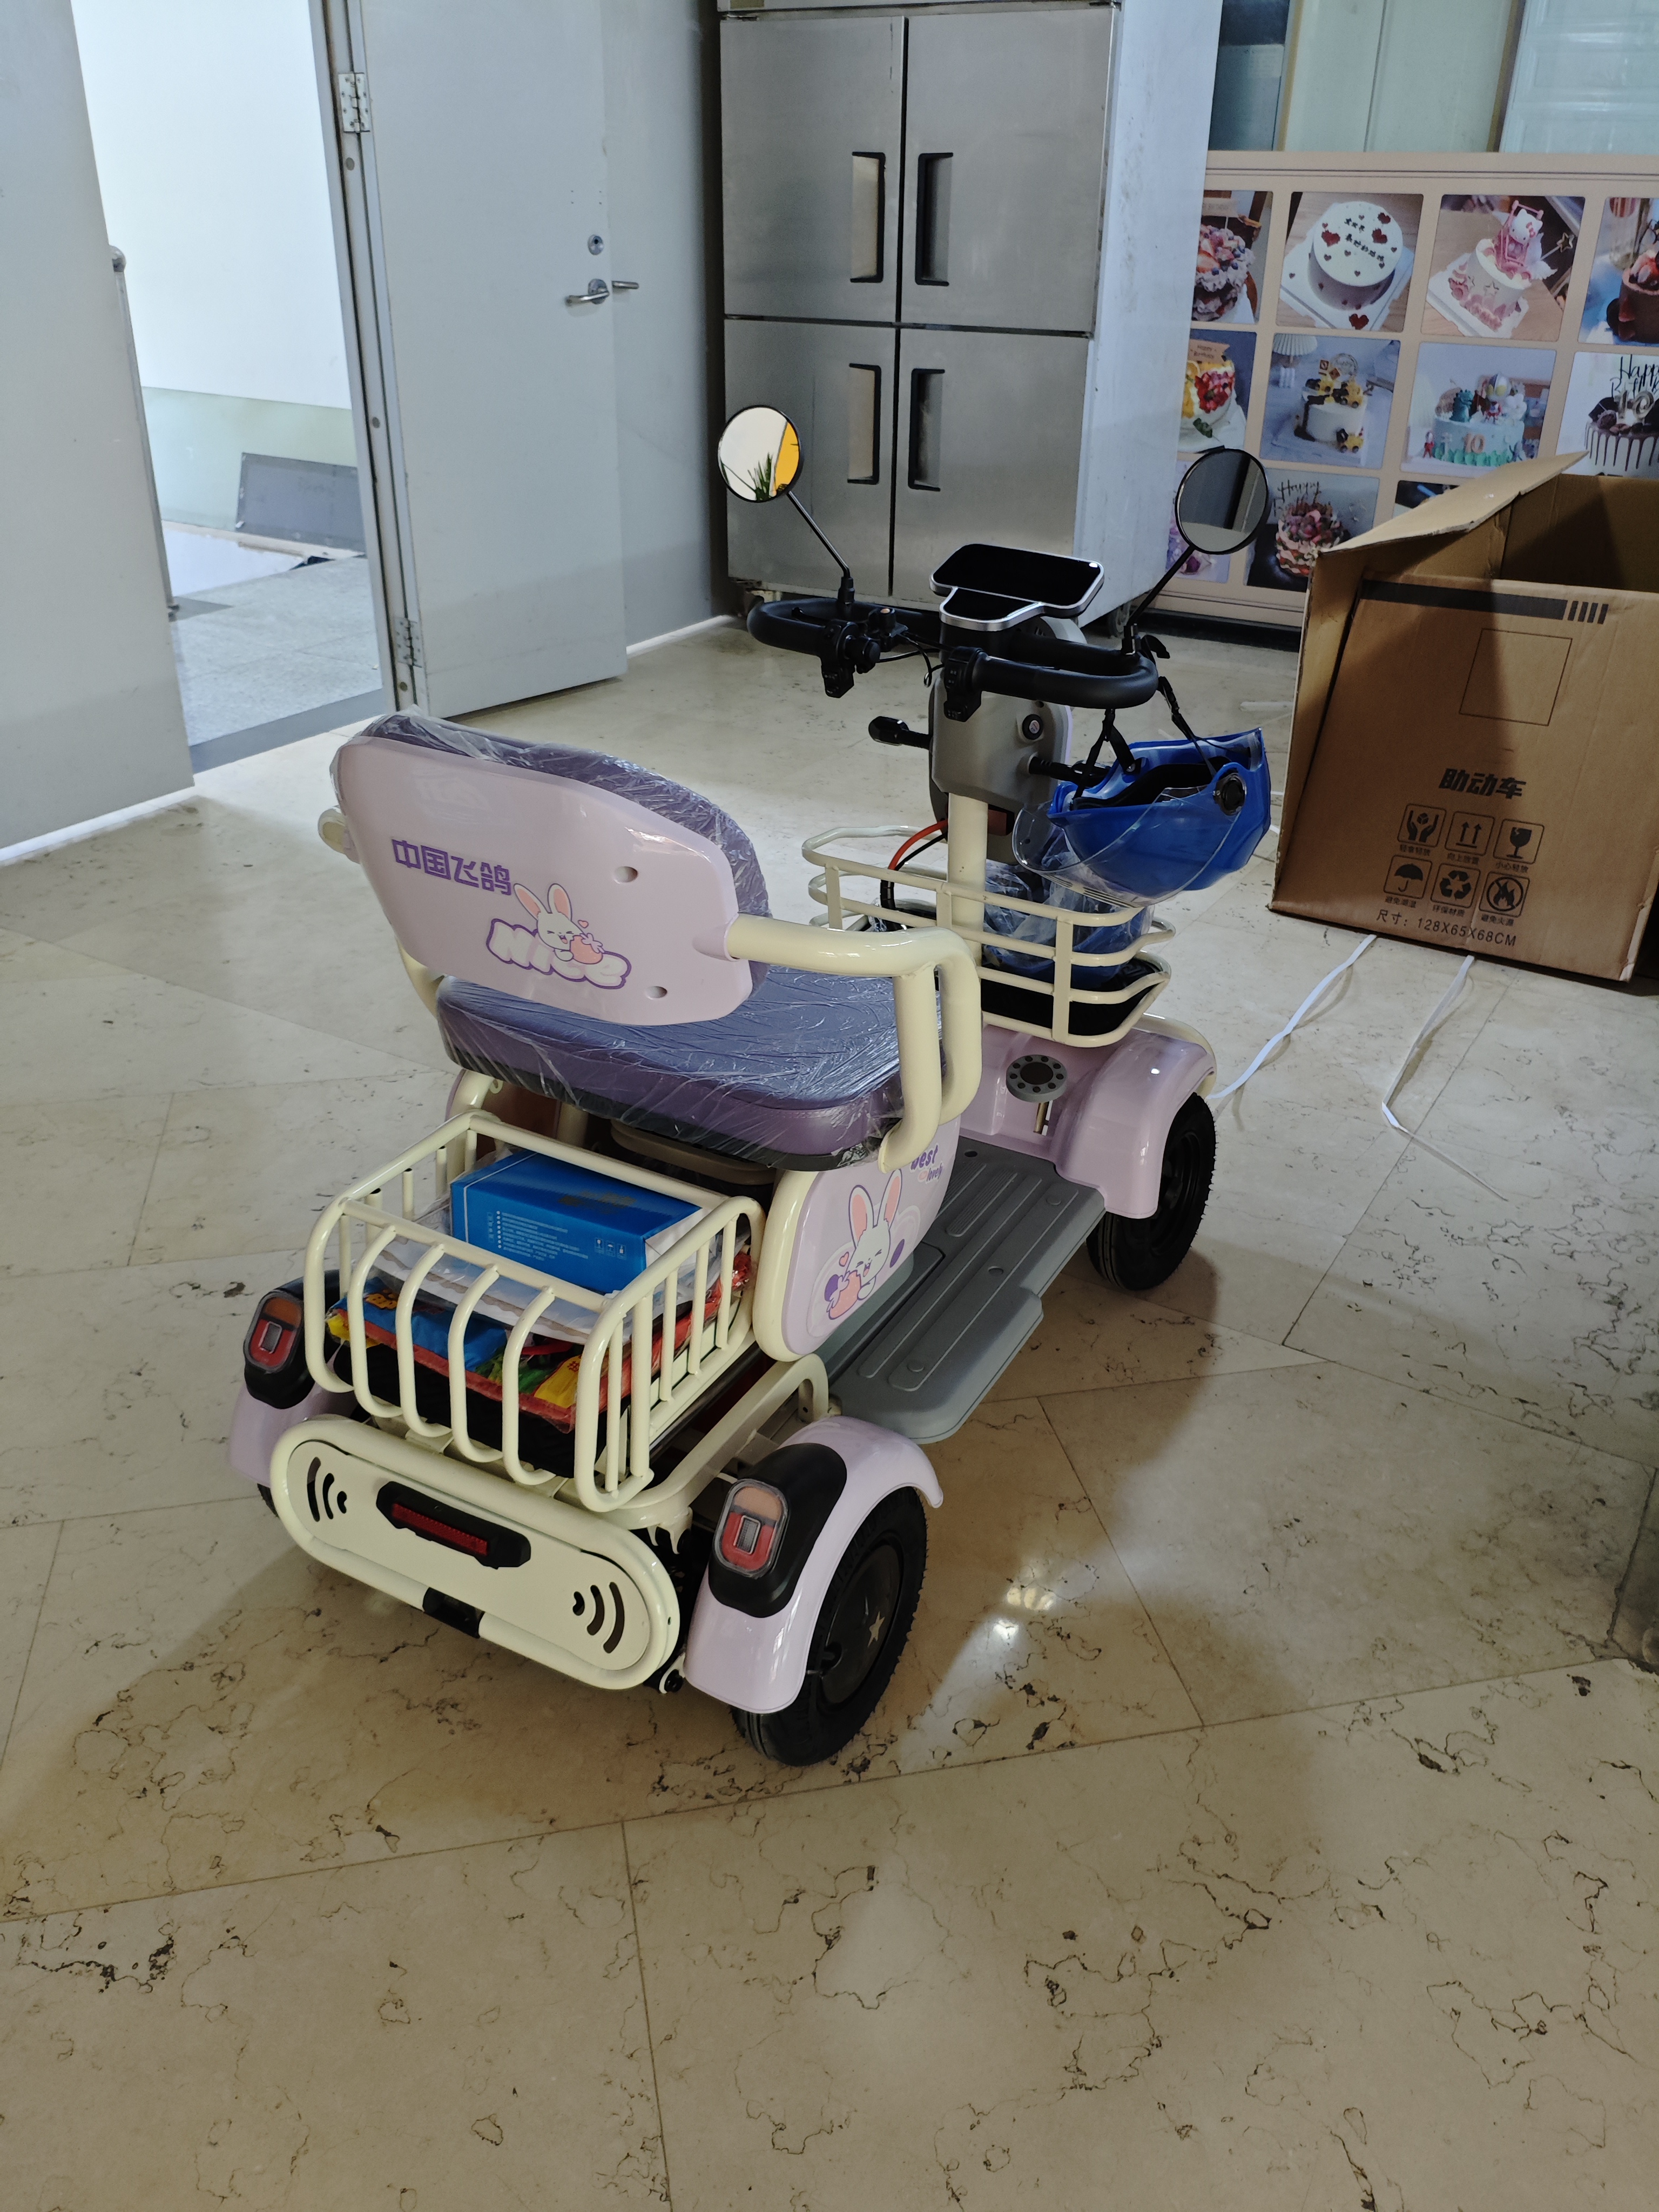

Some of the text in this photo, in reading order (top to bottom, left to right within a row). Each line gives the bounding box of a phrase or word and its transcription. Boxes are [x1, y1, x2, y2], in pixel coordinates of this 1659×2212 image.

[1619, 354, 1659, 387] Happ
[1462, 433, 1485, 454] 10
[1439, 768, 1527, 799] 助动车
[392, 839, 512, 896] 中国飞鸽
